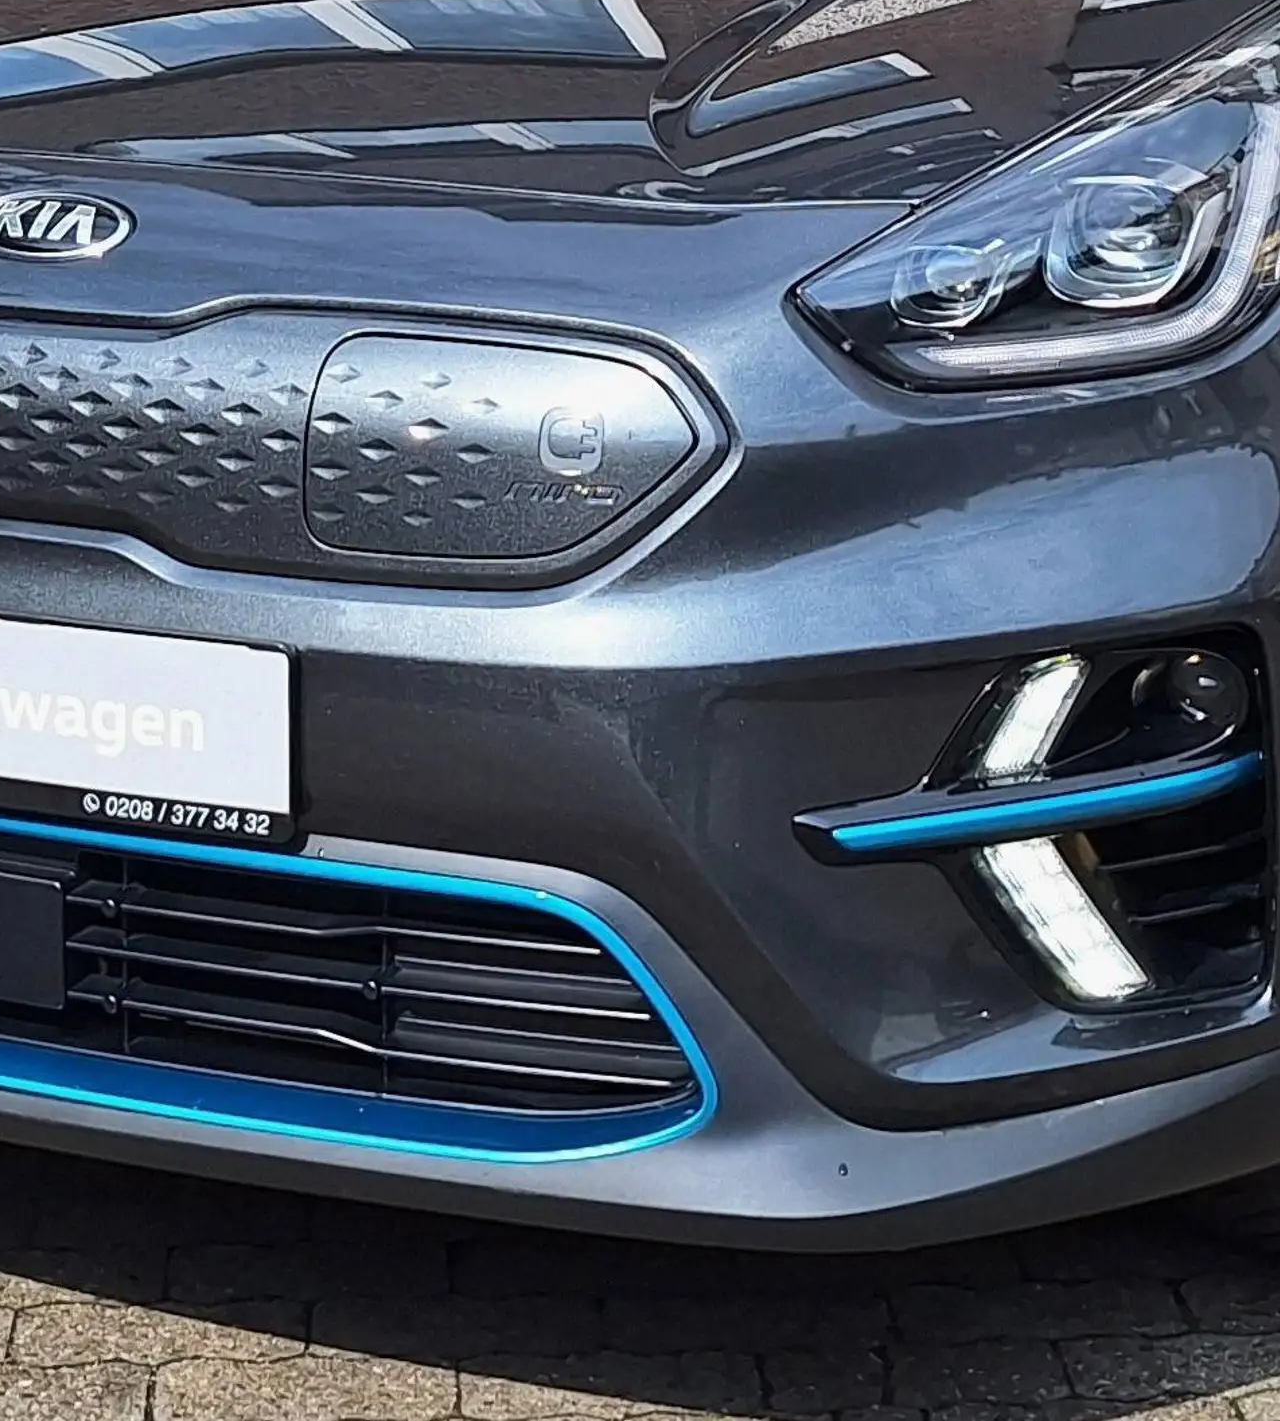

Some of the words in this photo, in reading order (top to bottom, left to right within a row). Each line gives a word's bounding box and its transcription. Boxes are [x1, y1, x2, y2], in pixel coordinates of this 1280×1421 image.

[105, 795, 154, 822] 0208
[171, 803, 210, 828] 377
[213, 809, 239, 832] 34
[243, 812, 270, 836] 32
